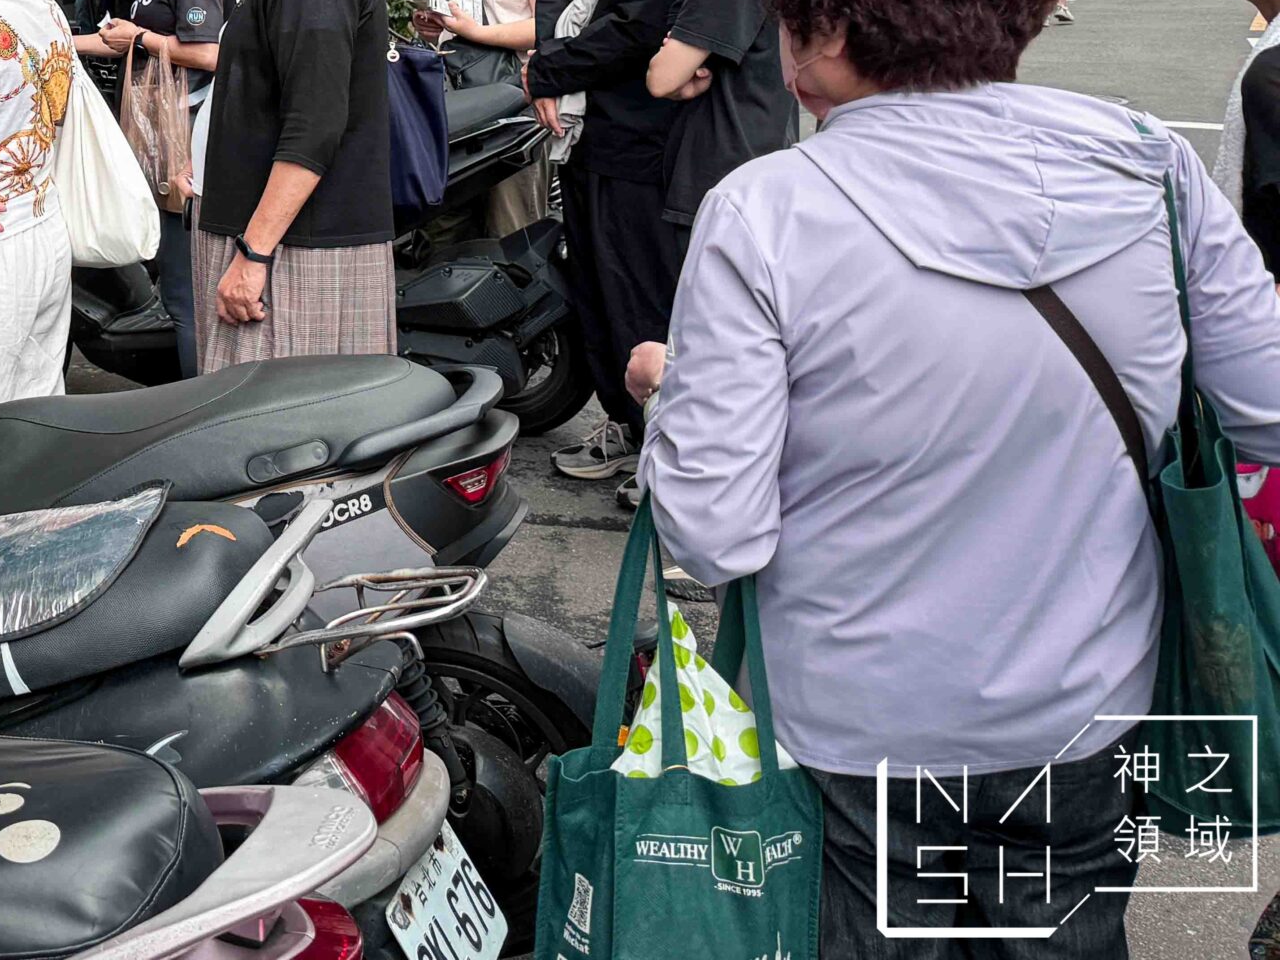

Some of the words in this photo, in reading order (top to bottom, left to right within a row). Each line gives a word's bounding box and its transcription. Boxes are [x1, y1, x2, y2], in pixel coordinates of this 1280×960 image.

[188, 12, 204, 21] RUN
[636, 840, 709, 860] WEALTHY
[720, 833, 742, 857] W
[412, 849, 442, 908] 台北市
[736, 860, 756, 882] H
